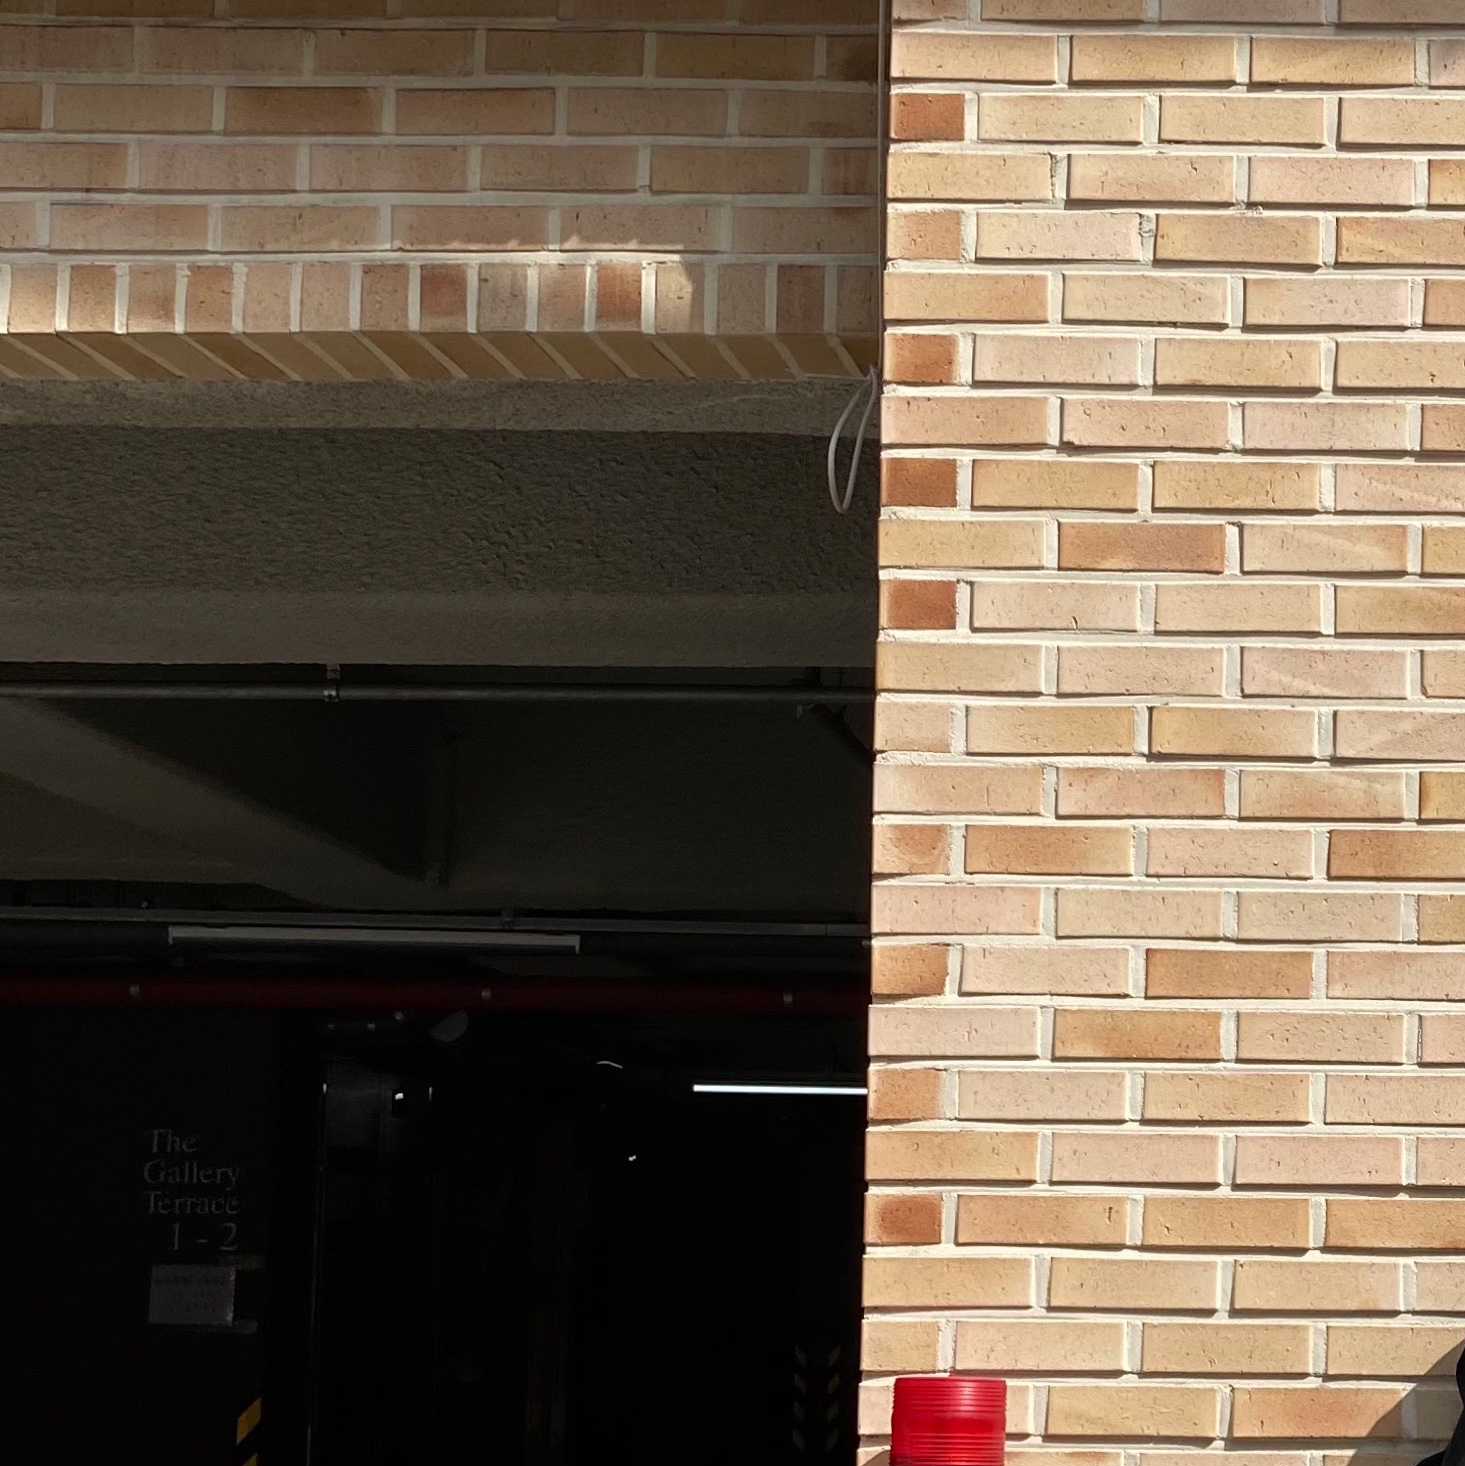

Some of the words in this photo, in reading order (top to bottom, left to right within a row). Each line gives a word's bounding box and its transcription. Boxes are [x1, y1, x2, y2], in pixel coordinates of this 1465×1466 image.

[145, 1128, 200, 1153] The
[143, 1159, 240, 1191] Gallery
[144, 1190, 241, 1215] Terrace
